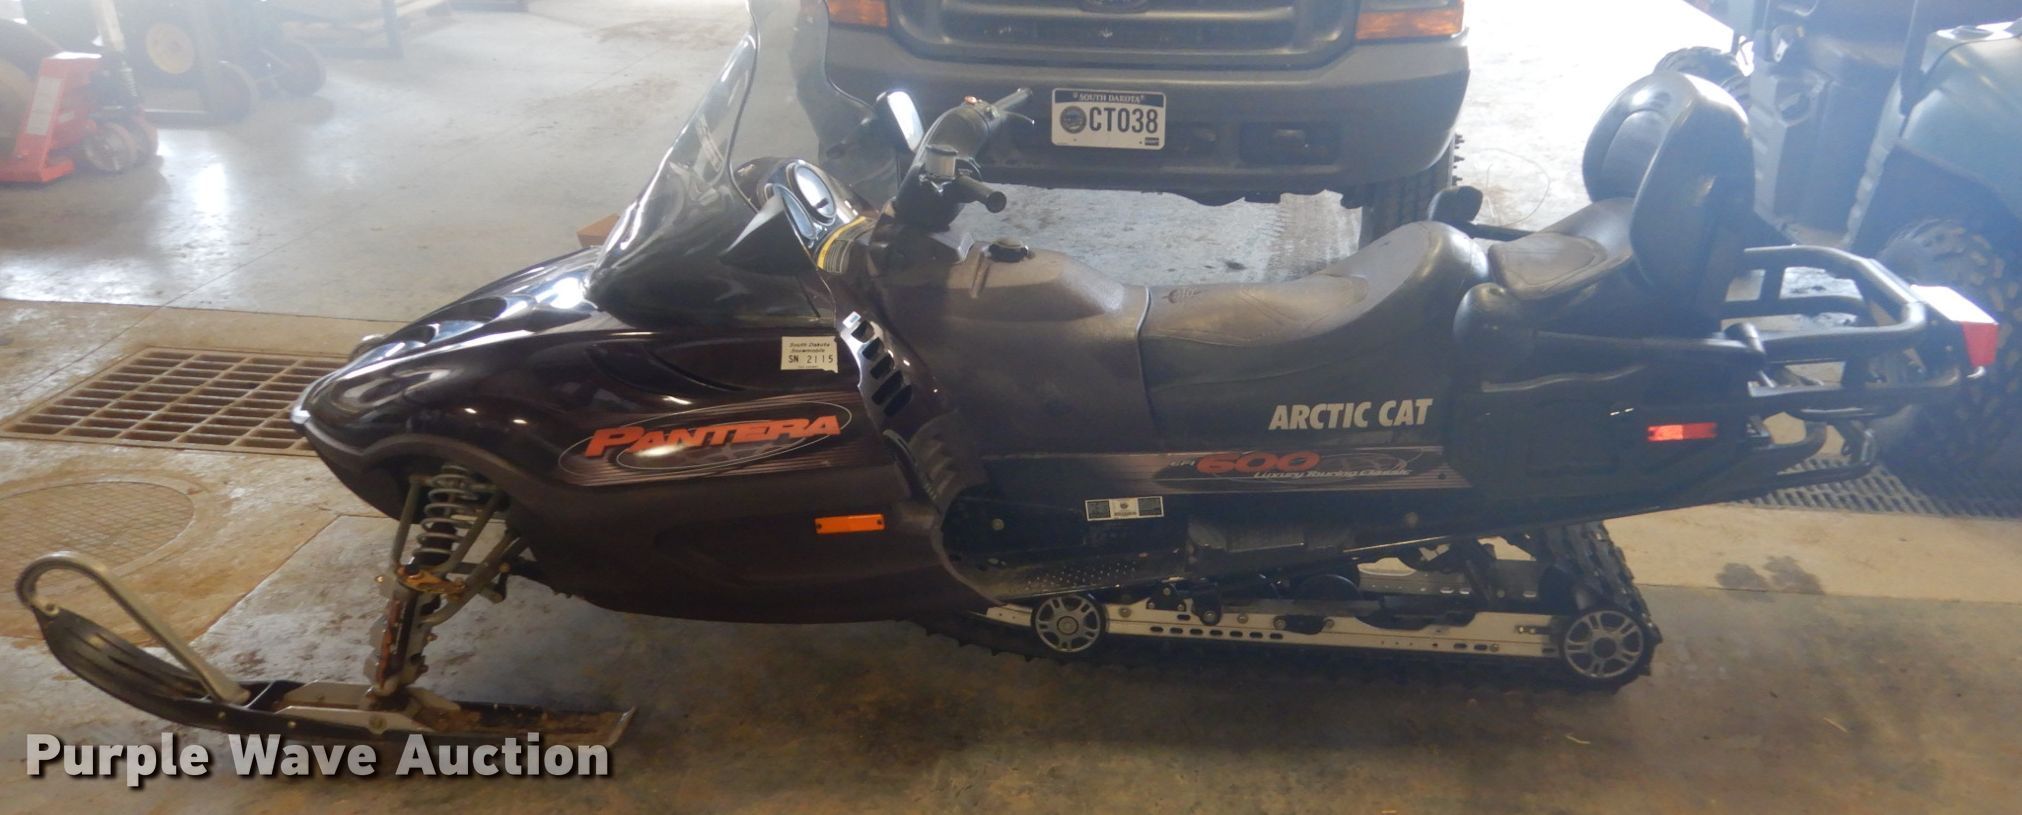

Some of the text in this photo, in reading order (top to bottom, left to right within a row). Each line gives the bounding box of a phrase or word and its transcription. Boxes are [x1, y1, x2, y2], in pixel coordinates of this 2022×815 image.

[1079, 93, 1141, 104] SOUTH DAKOTA
[1089, 107, 1158, 133] CT038
[788, 355, 799, 363] SN
[1268, 398, 1434, 430] ARCTIC CAT
[1196, 451, 1321, 474] 600
[1253, 471, 1306, 480] Luxury
[1306, 469, 1357, 479] Touring
